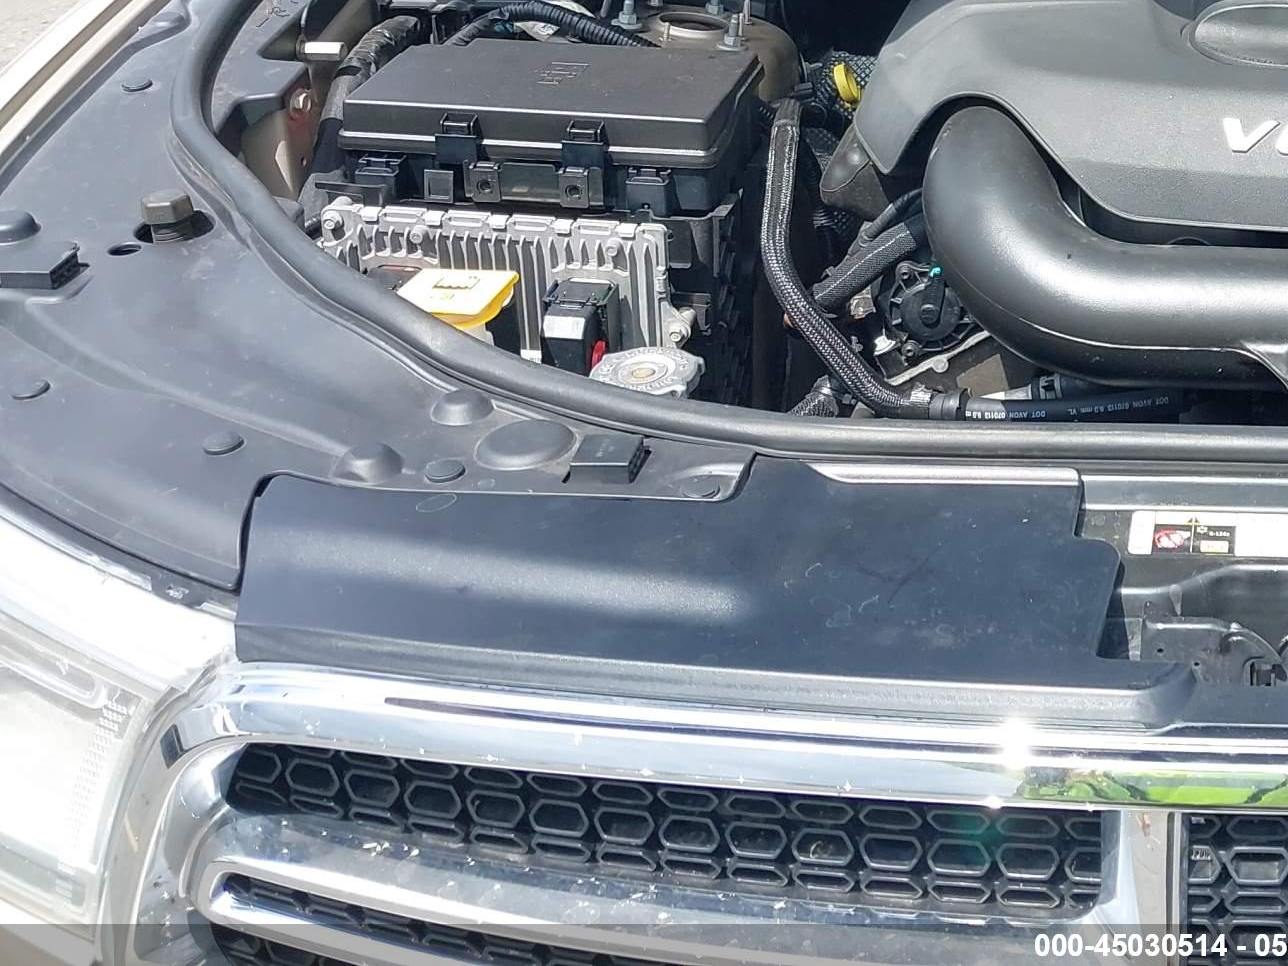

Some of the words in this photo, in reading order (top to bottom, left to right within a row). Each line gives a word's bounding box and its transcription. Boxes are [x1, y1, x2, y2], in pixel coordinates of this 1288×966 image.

[1133, 398, 1152, 408] AVON
[1155, 396, 1169, 405] DOT
[1009, 411, 1028, 419] AVON
[1032, 410, 1046, 418] DOT
